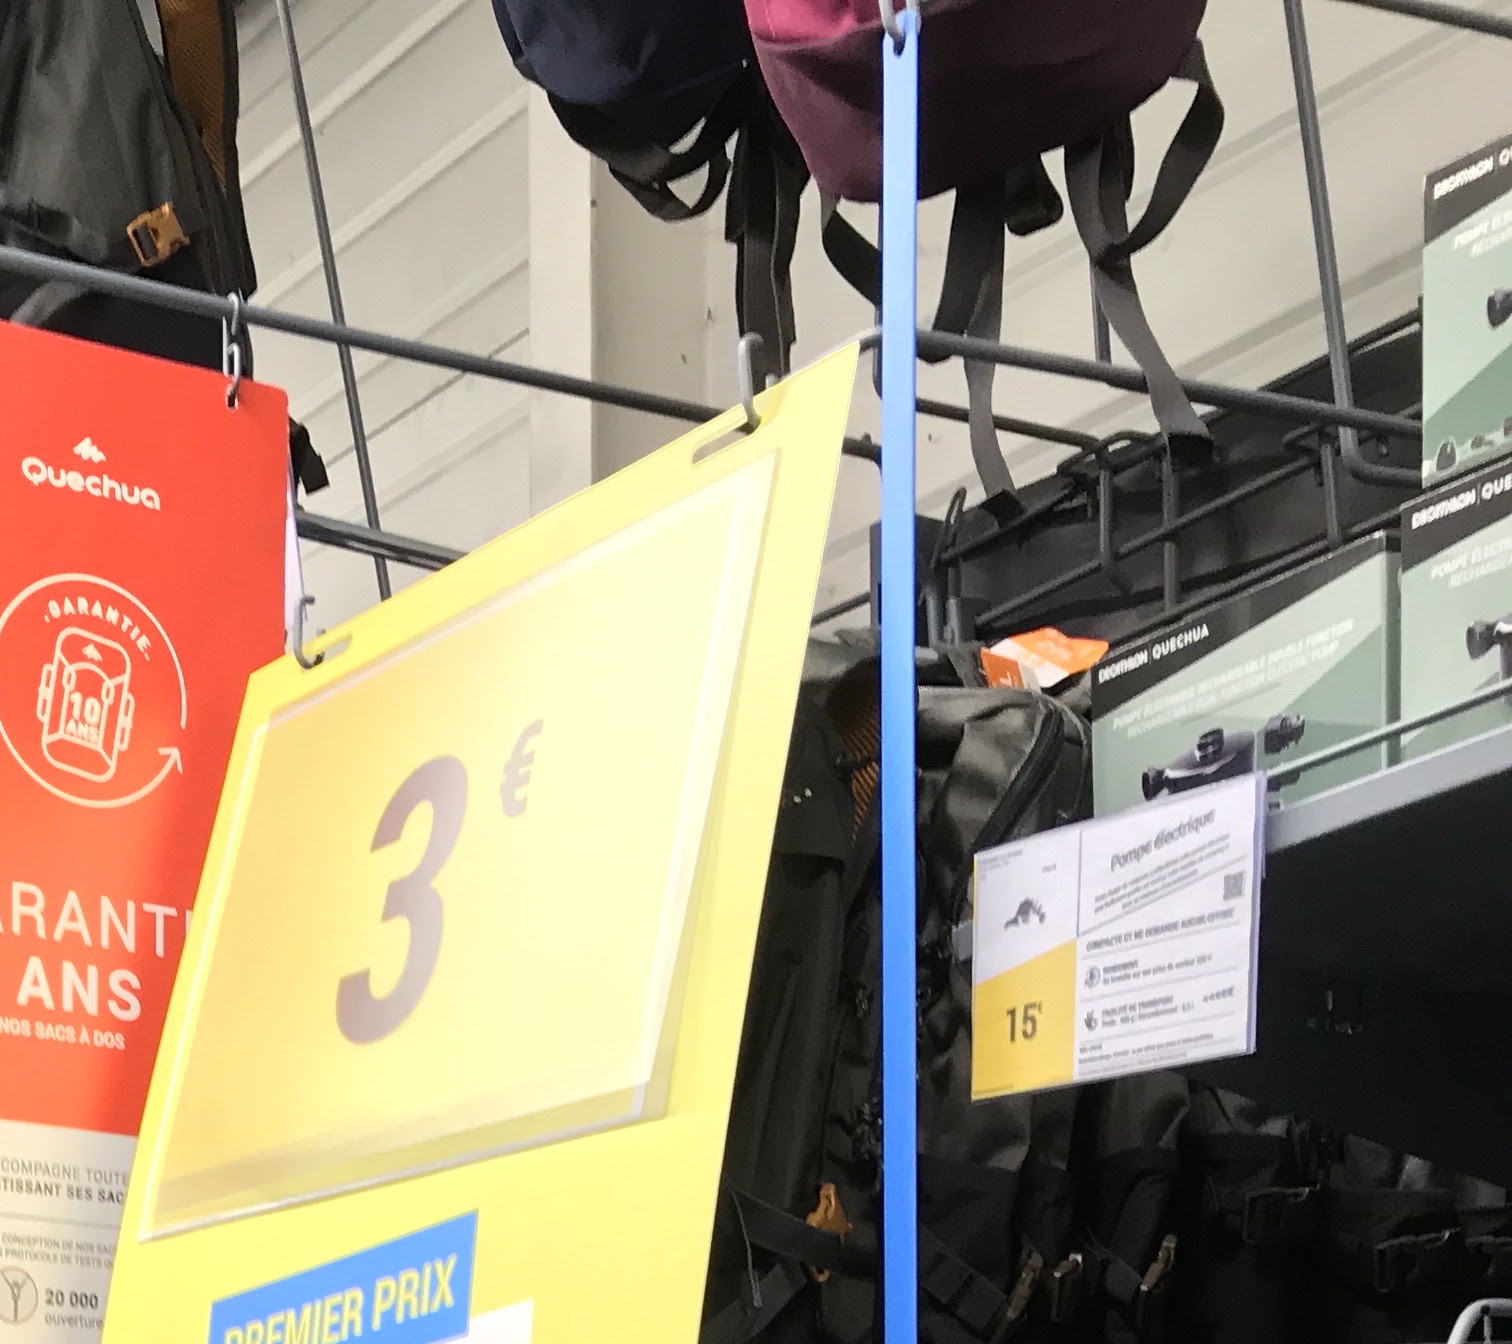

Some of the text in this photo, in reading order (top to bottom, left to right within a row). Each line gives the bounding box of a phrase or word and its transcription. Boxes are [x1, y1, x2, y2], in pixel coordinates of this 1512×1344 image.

[21, 456, 161, 511] Quechua
[1152, 623, 1210, 661] QUECHUA
[70, 692, 102, 726] 10
[65, 720, 101, 745] ANS
[1110, 809, 1216, 872] Pompe électrique
[335, 718, 545, 1045] 3 €
[16, 955, 142, 1022] ANS
[35, 1021, 77, 1045] SACS
[79, 1025, 91, 1047] À
[93, 1030, 126, 1051] DOS
[66, 1184, 93, 1201] SES
[44, 1287, 99, 1310] 20 000
[371, 1253, 458, 1332] PRIX
